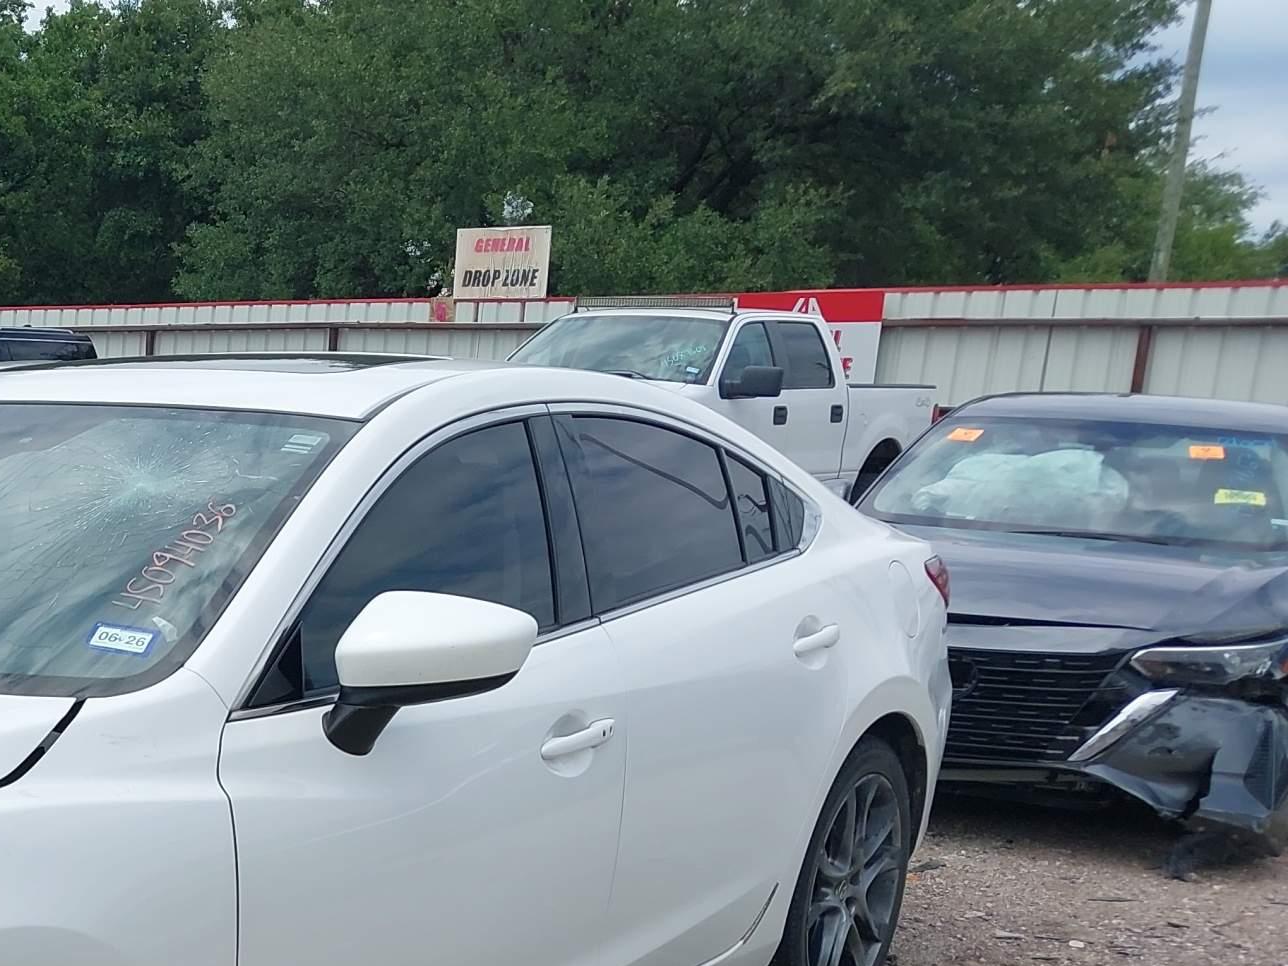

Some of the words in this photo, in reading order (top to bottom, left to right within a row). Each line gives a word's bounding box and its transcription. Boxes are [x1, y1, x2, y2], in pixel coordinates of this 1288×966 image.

[474, 237, 530, 253] GENERAL
[462, 269, 500, 287] DROP
[502, 268, 539, 287] ZONE
[111, 500, 236, 610] 45094036
